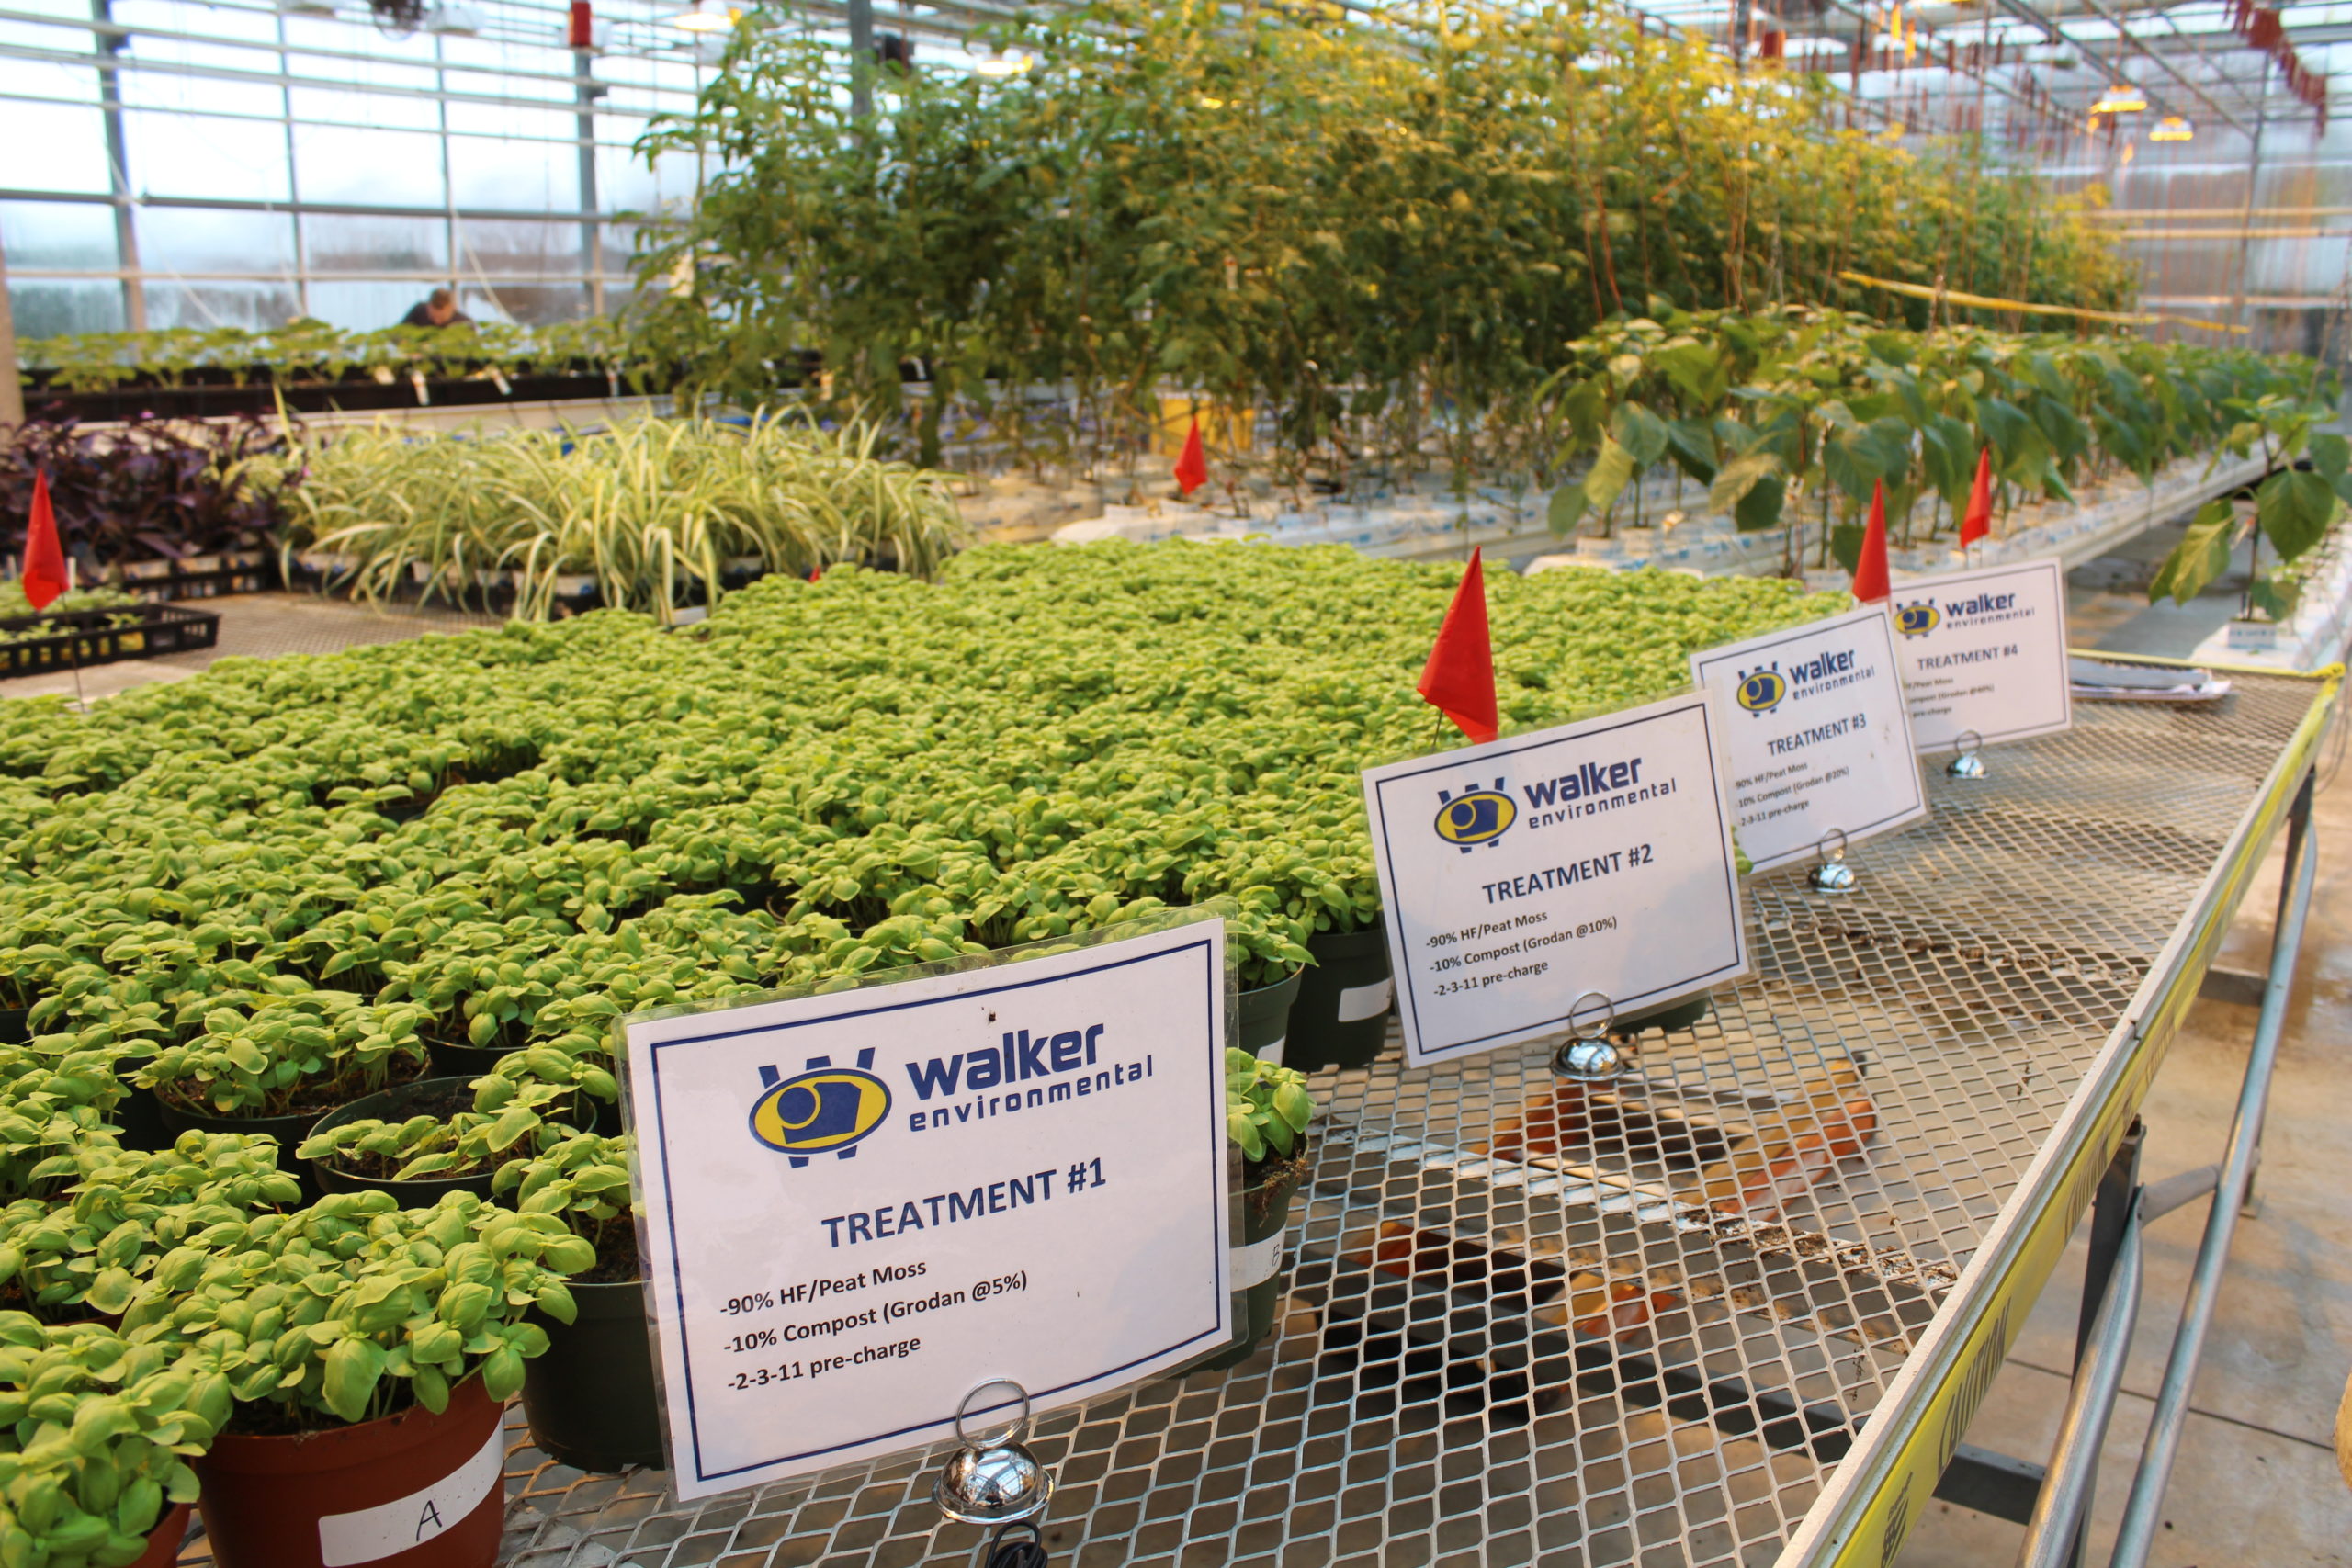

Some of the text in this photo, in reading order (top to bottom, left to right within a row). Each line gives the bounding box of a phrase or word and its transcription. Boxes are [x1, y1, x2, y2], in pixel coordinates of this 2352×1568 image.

[1946, 593, 2016, 618] walker
[1947, 607, 2035, 629] environmental
[1790, 649, 1855, 685] walker
[1917, 644, 2018, 671] TREATMENT #4
[1792, 666, 1875, 700] environmental
[1768, 713, 1866, 757] TREATMENT #3
[1523, 758, 1641, 809] walker
[1529, 778, 1676, 829] environmental
[1482, 844, 1653, 904] TREATMENT #2
[1426, 913, 1547, 948] -90% HF/Peat Moss
[1430, 917, 1617, 972] -10% Compost (Grodan @10%)
[1434, 963, 1547, 996] -2-3-11 pre-charge
[906, 1023, 1103, 1100] walker
[910, 1055, 1152, 1132] environmental
[821, 1157, 1105, 1247] TREATMENT #1
[720, 1263, 926, 1315] -90% HF/Peat Moss
[725, 1271, 1026, 1352] -10% Compost (Grodan @5%)
[729, 1339, 920, 1389] -2-3-11 pre-charge
[416, 1500, 443, 1542] A
